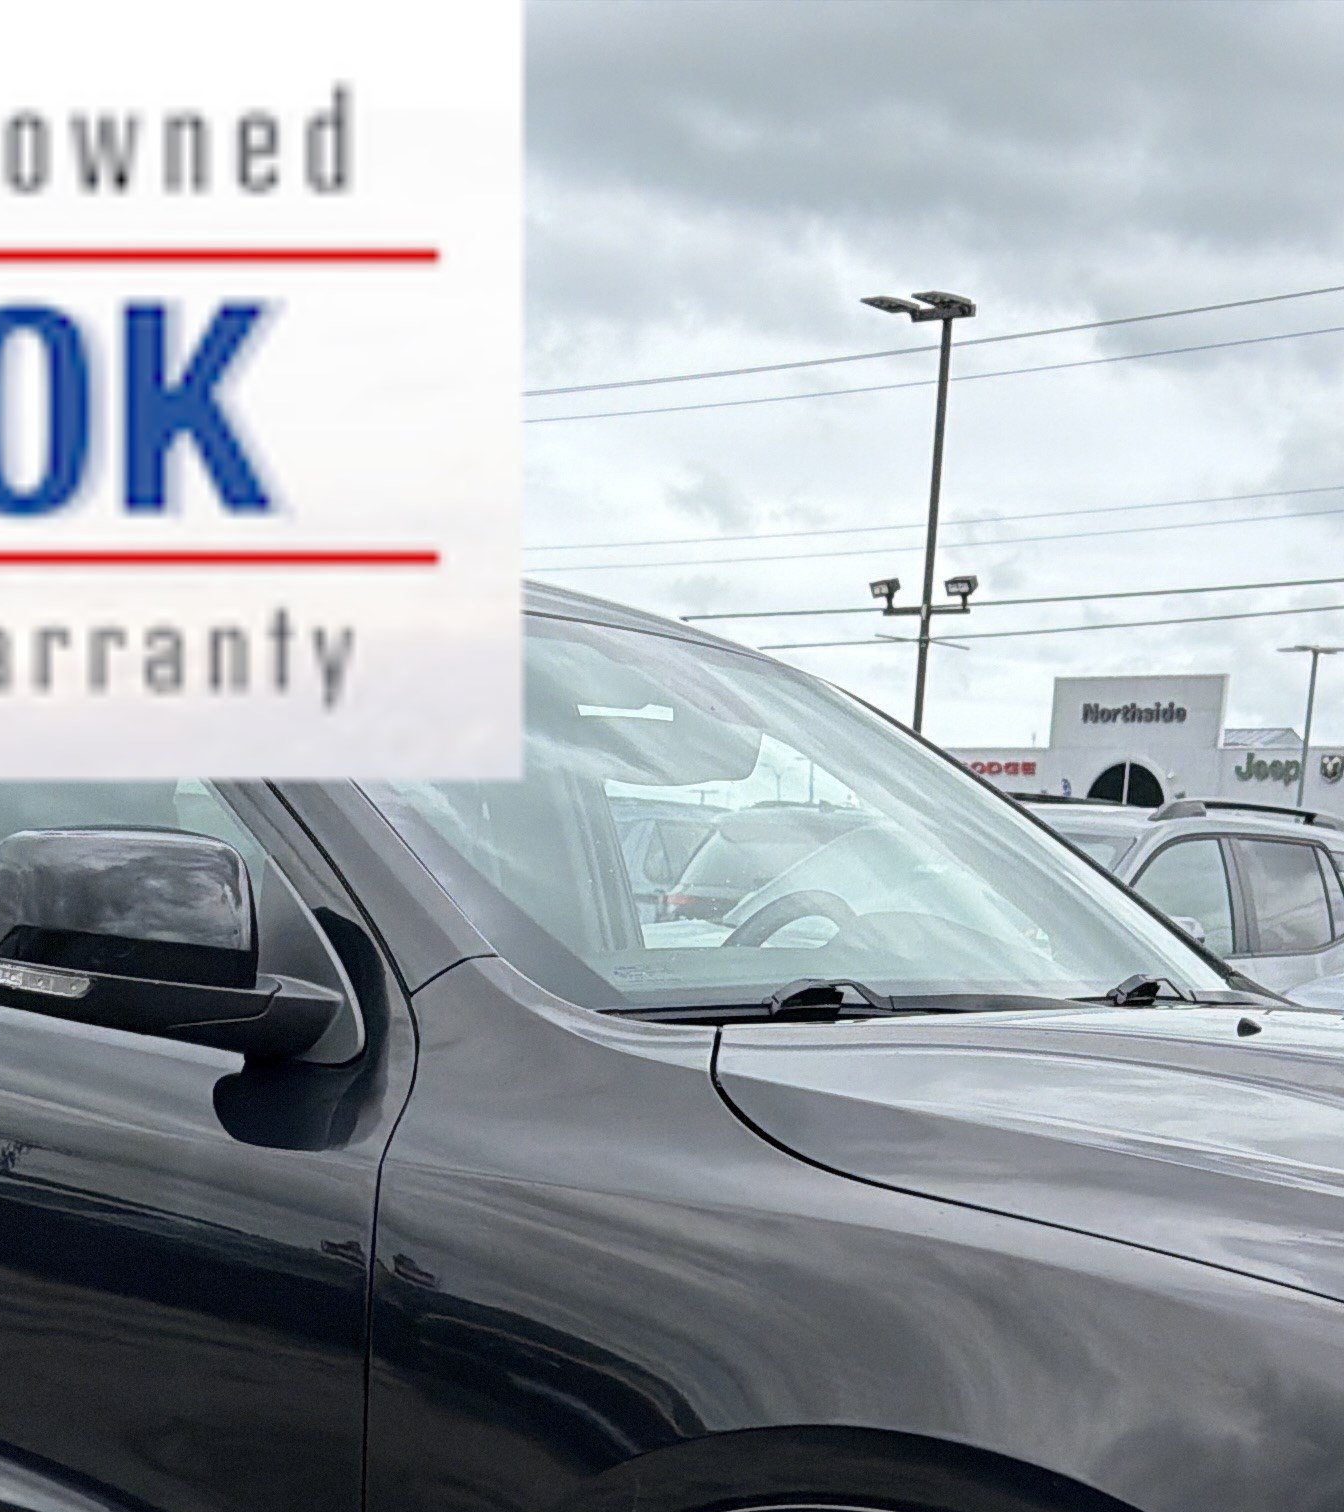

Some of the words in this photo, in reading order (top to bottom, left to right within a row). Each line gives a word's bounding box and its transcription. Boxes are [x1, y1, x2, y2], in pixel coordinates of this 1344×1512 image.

[1082, 702, 1187, 724] Northside
[970, 761, 1037, 775] ODGE
[1235, 752, 1301, 786] Jeep
